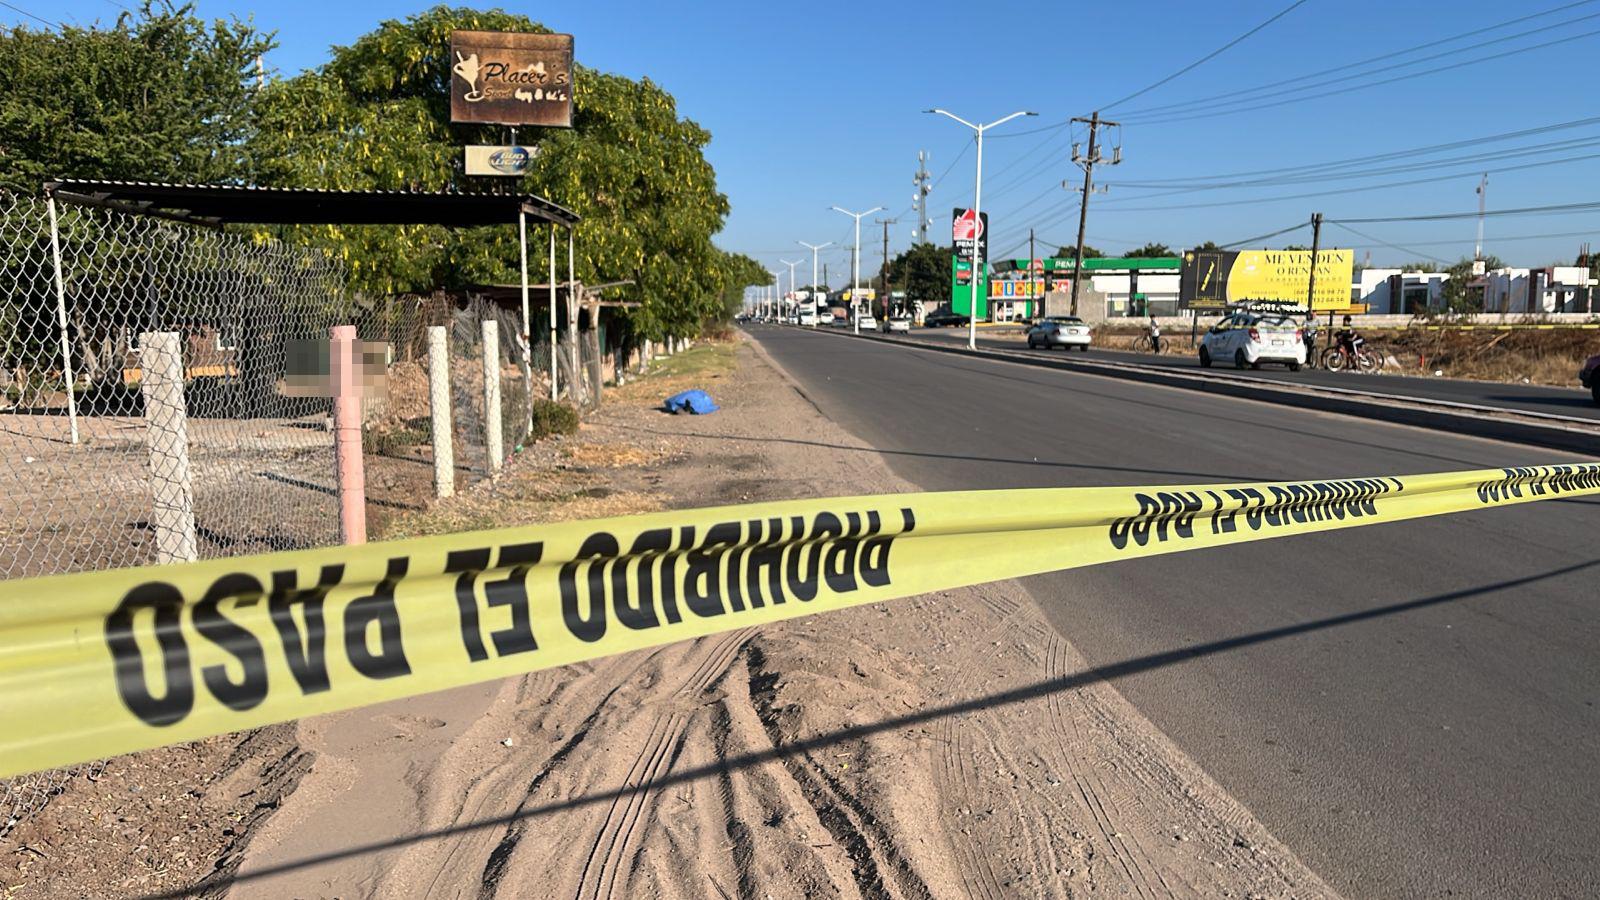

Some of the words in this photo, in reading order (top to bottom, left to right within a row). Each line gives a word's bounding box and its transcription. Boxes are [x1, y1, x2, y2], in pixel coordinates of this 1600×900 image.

[956, 240, 985, 248] PEMX
[1265, 254, 1286, 264] ME
[1290, 253, 1345, 264] VENDEN
[1288, 266, 1331, 275] RENAN
[444, 541, 544, 662] EL
[559, 508, 916, 643] PROHIBIDO
[105, 556, 412, 727] PASO
